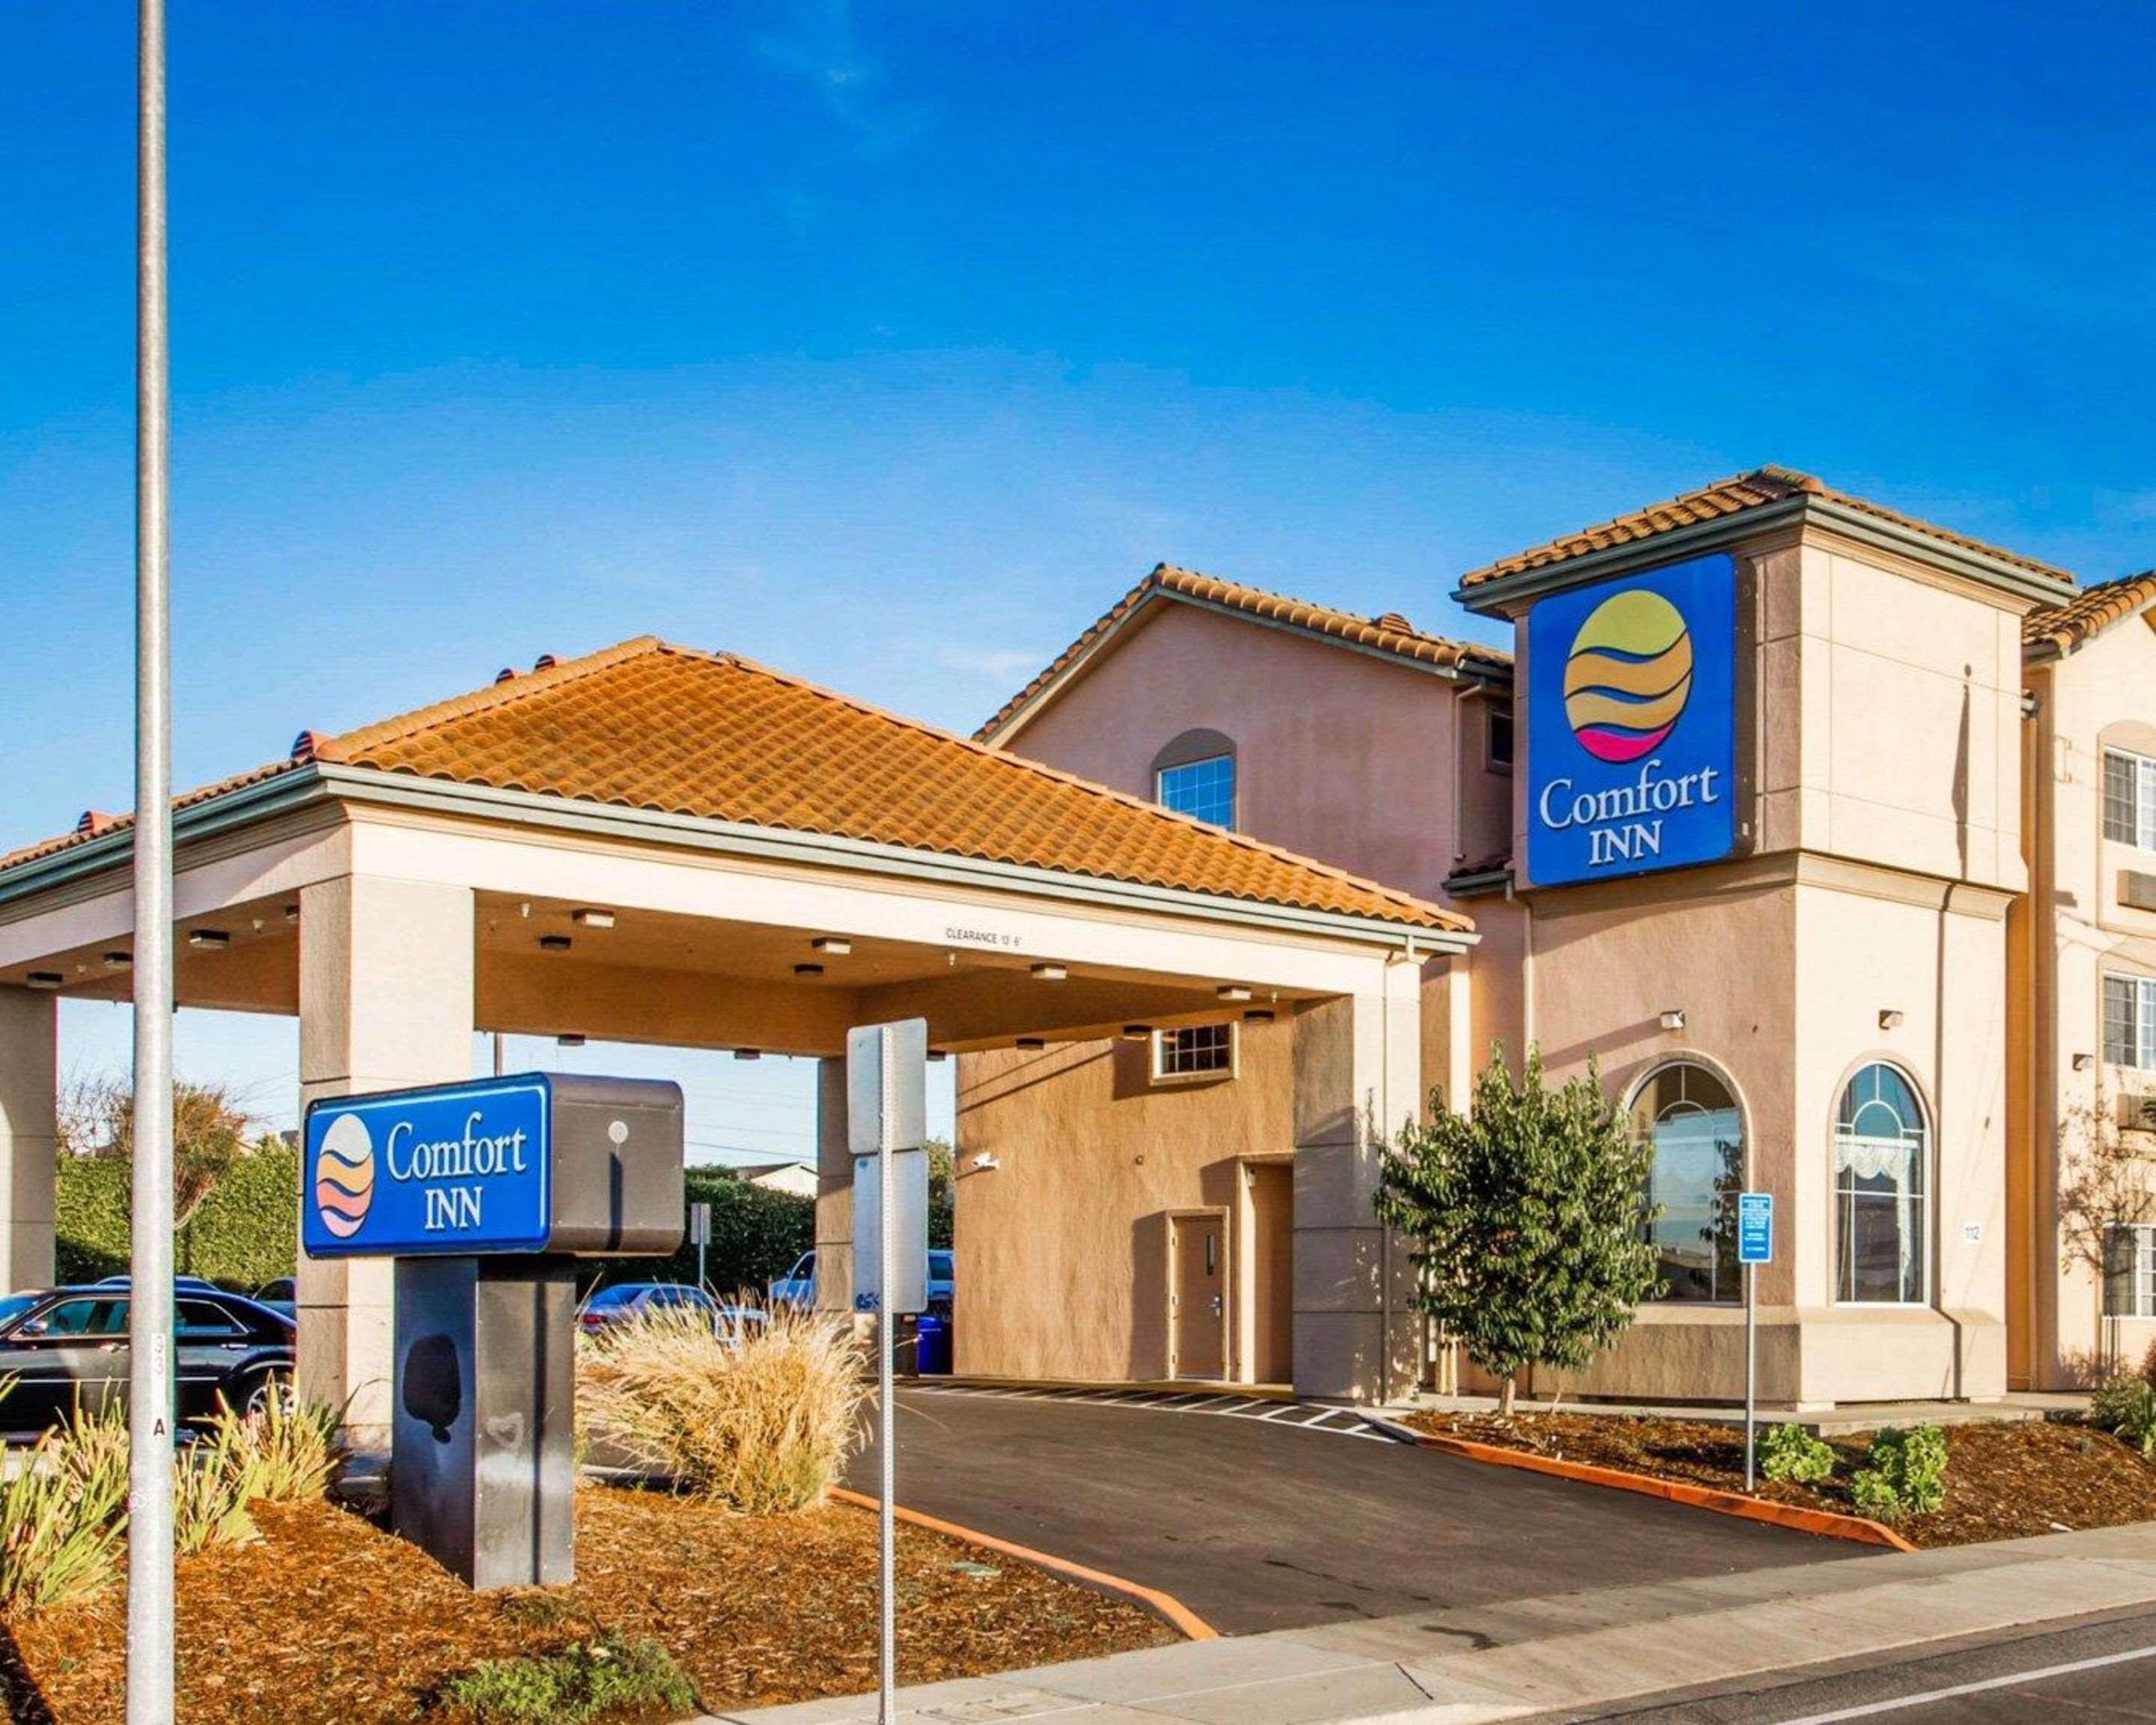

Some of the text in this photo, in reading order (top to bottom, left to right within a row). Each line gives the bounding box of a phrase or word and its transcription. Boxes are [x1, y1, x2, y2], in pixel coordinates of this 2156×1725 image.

[1539, 759, 1718, 829] Comfort
[1589, 820, 1663, 865] INN
[945, 928, 997, 944] CLEARANCE
[387, 1111, 527, 1181] Comfort
[424, 1186, 483, 1230] INN
[153, 1417, 165, 1435] A
